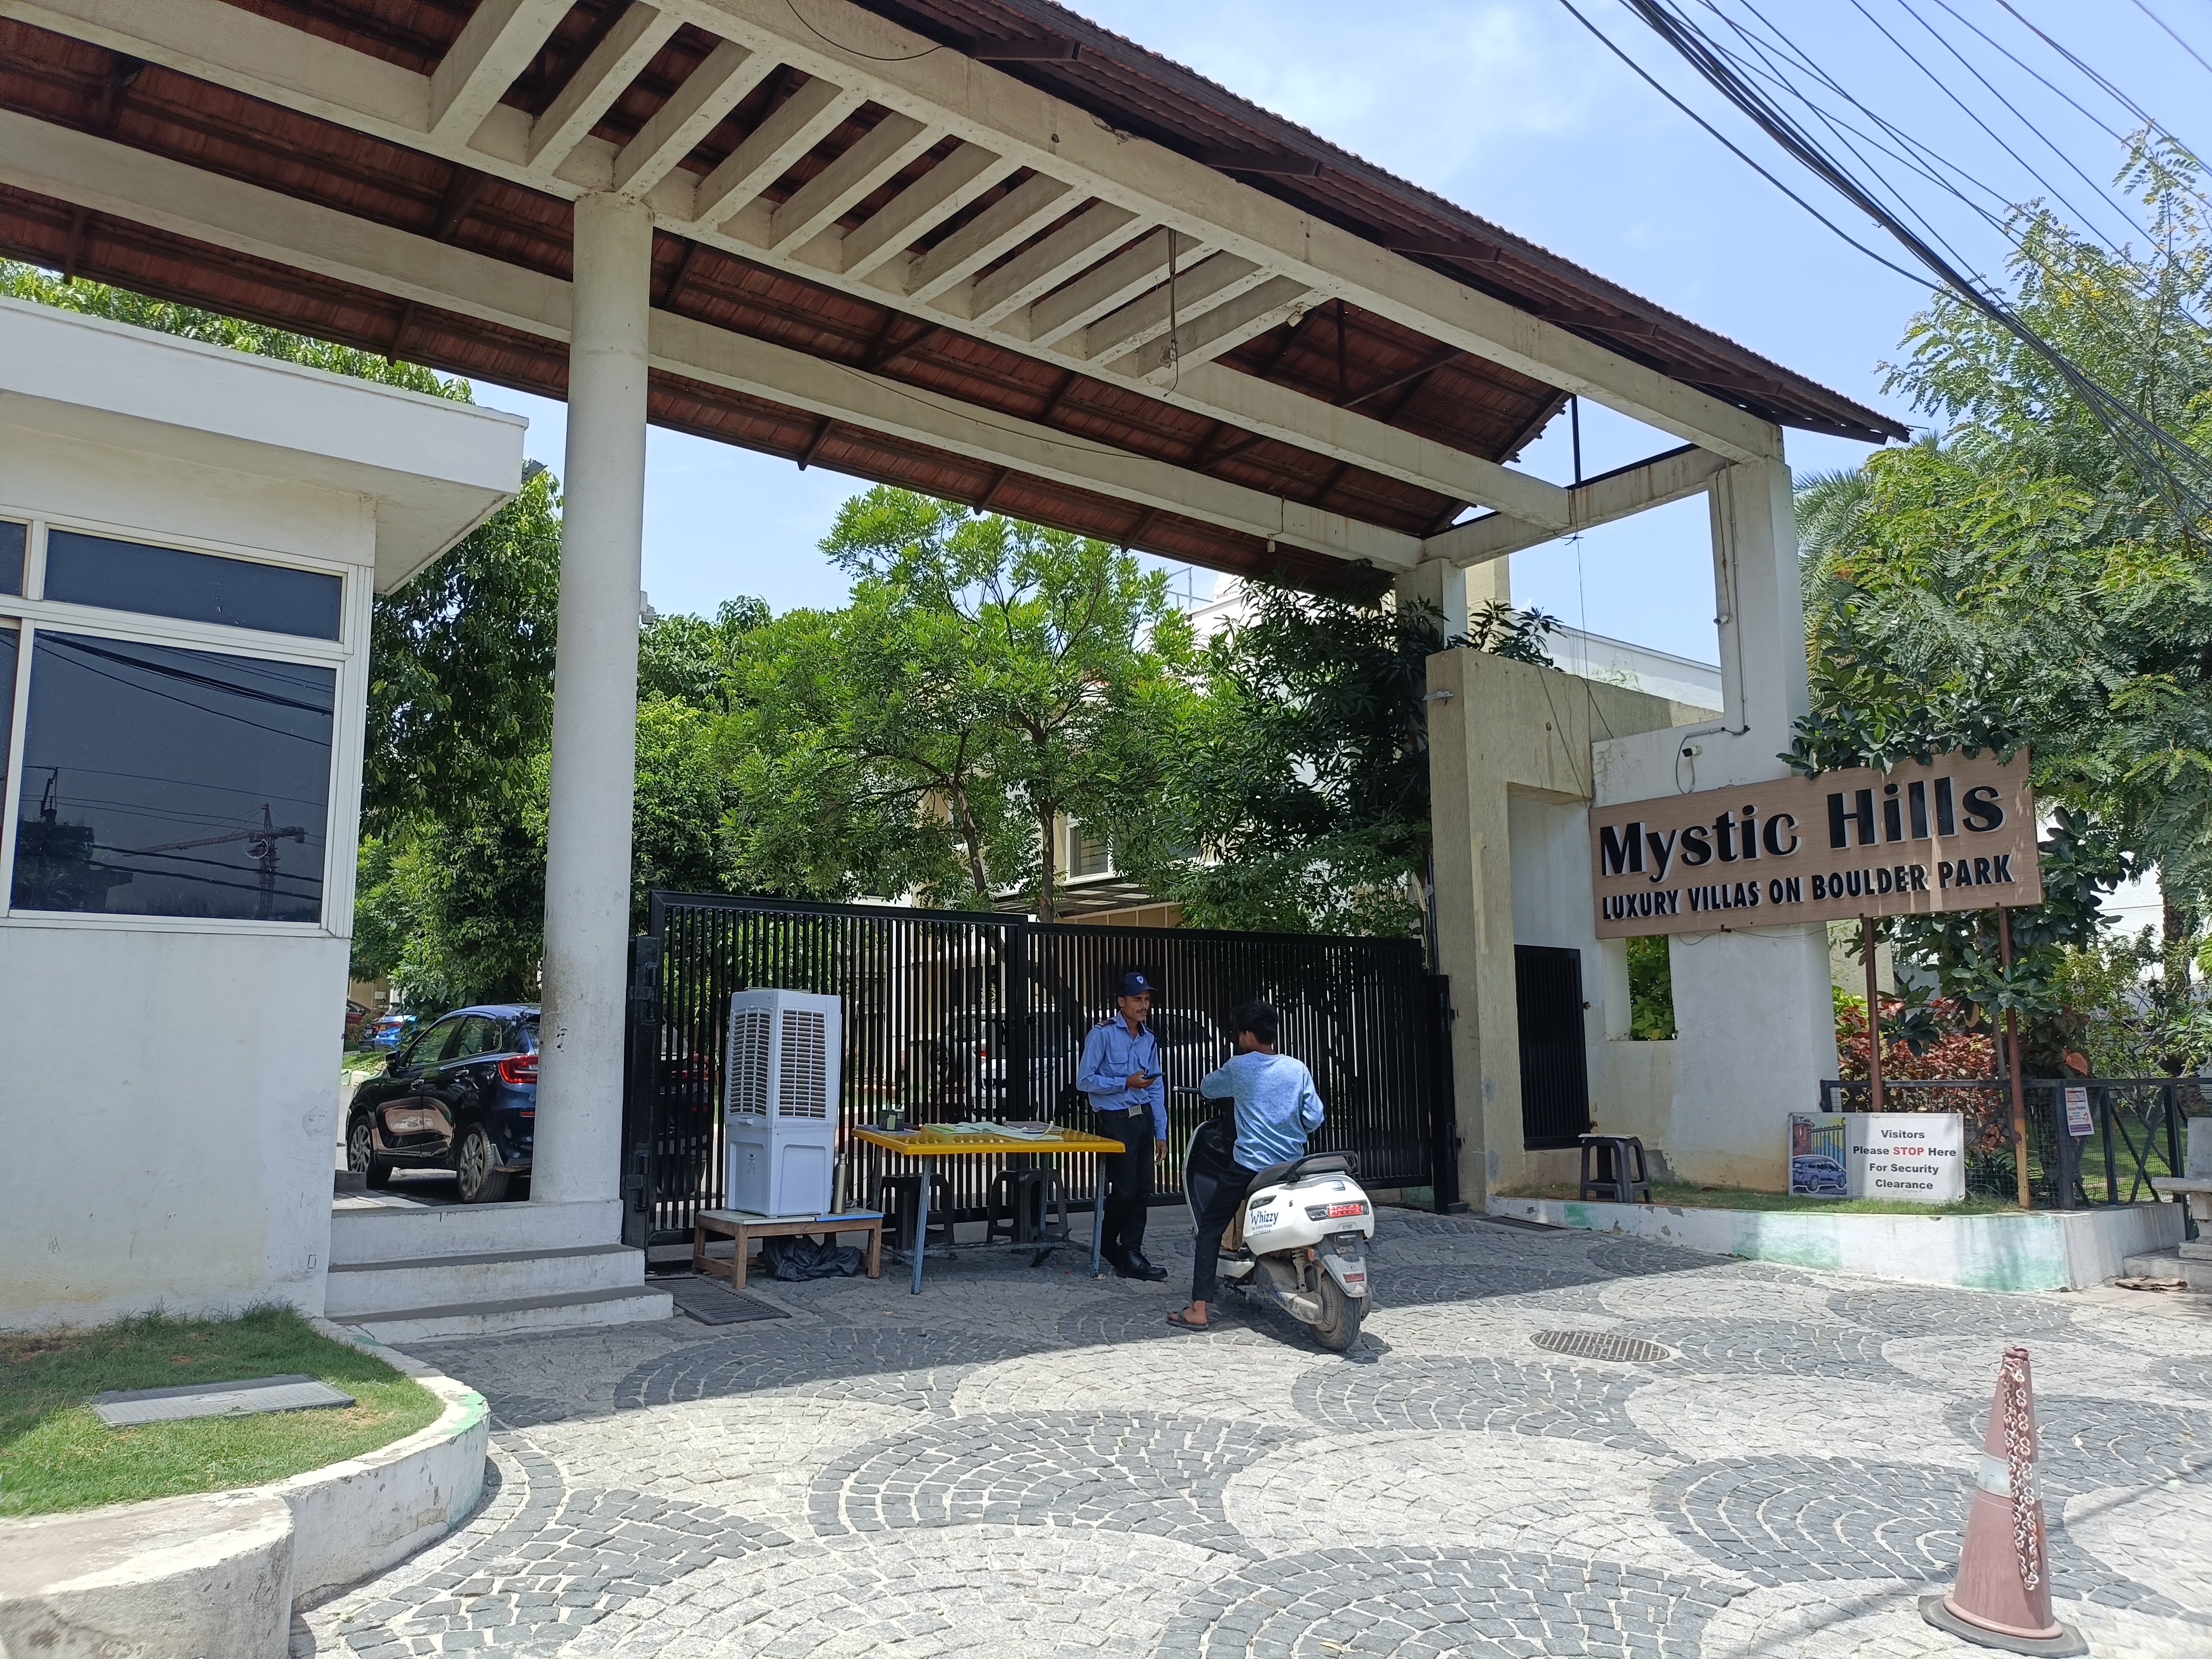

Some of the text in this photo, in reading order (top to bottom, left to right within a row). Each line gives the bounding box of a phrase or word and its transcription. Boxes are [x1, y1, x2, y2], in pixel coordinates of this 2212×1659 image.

[1600, 776, 2005, 883] Mystic Hills
[1602, 854, 2014, 922] LUXURY VILLAS ON BOULDER PARK
[1881, 1130, 1924, 1139] Visitors
[1853, 1146, 1956, 1156] Please STOP Here
[1869, 1163, 1939, 1175] For Security
[1876, 1179, 1933, 1189] Clearance
[1250, 1210, 1279, 1225] Whizzy
